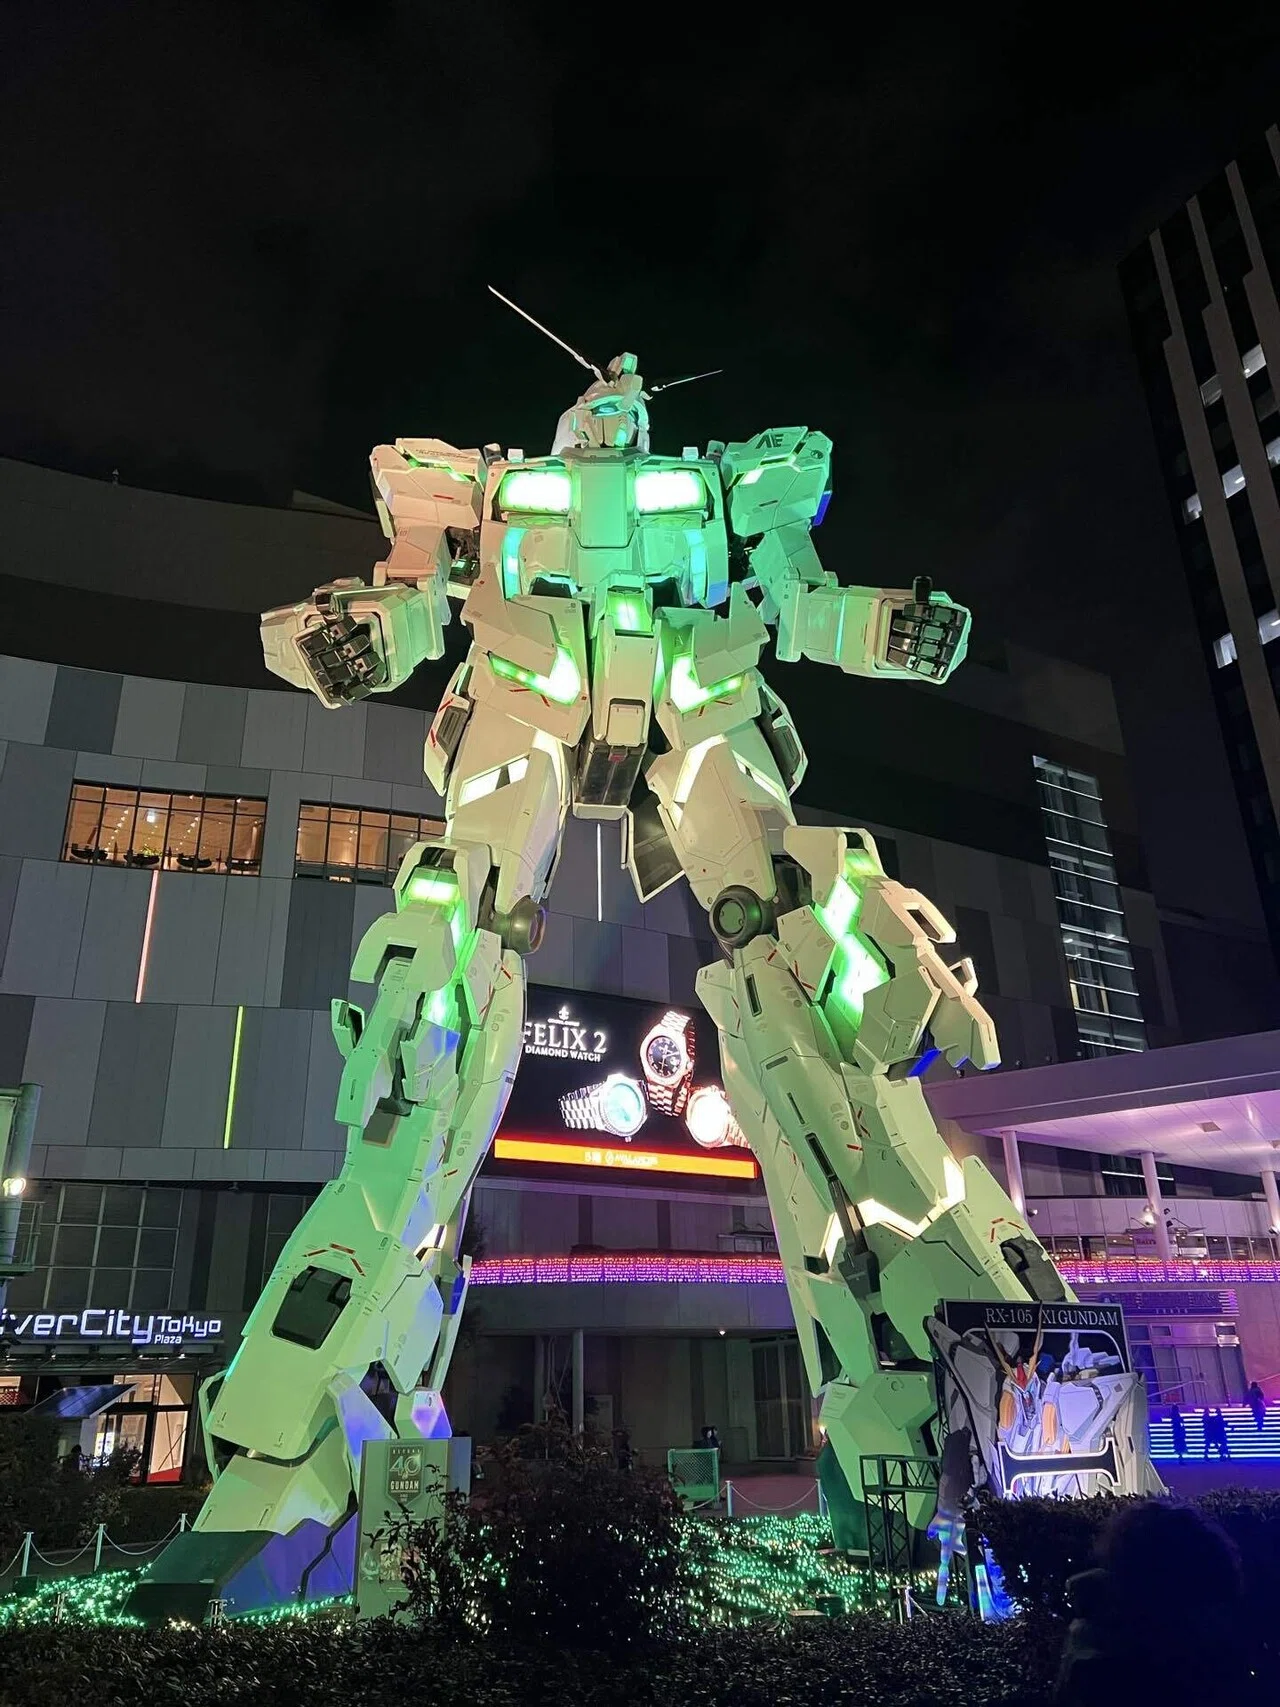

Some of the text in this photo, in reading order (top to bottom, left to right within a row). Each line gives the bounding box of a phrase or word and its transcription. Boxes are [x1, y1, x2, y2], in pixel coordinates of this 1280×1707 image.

[523, 1022, 607, 1054] FELIX 2
[525, 1045, 601, 1063] DIAMOND WATCH
[985, 1307, 1033, 1323] RX-105
[154, 1335, 182, 1345] Plaza
[390, 1480, 419, 1490] GUNDAM
